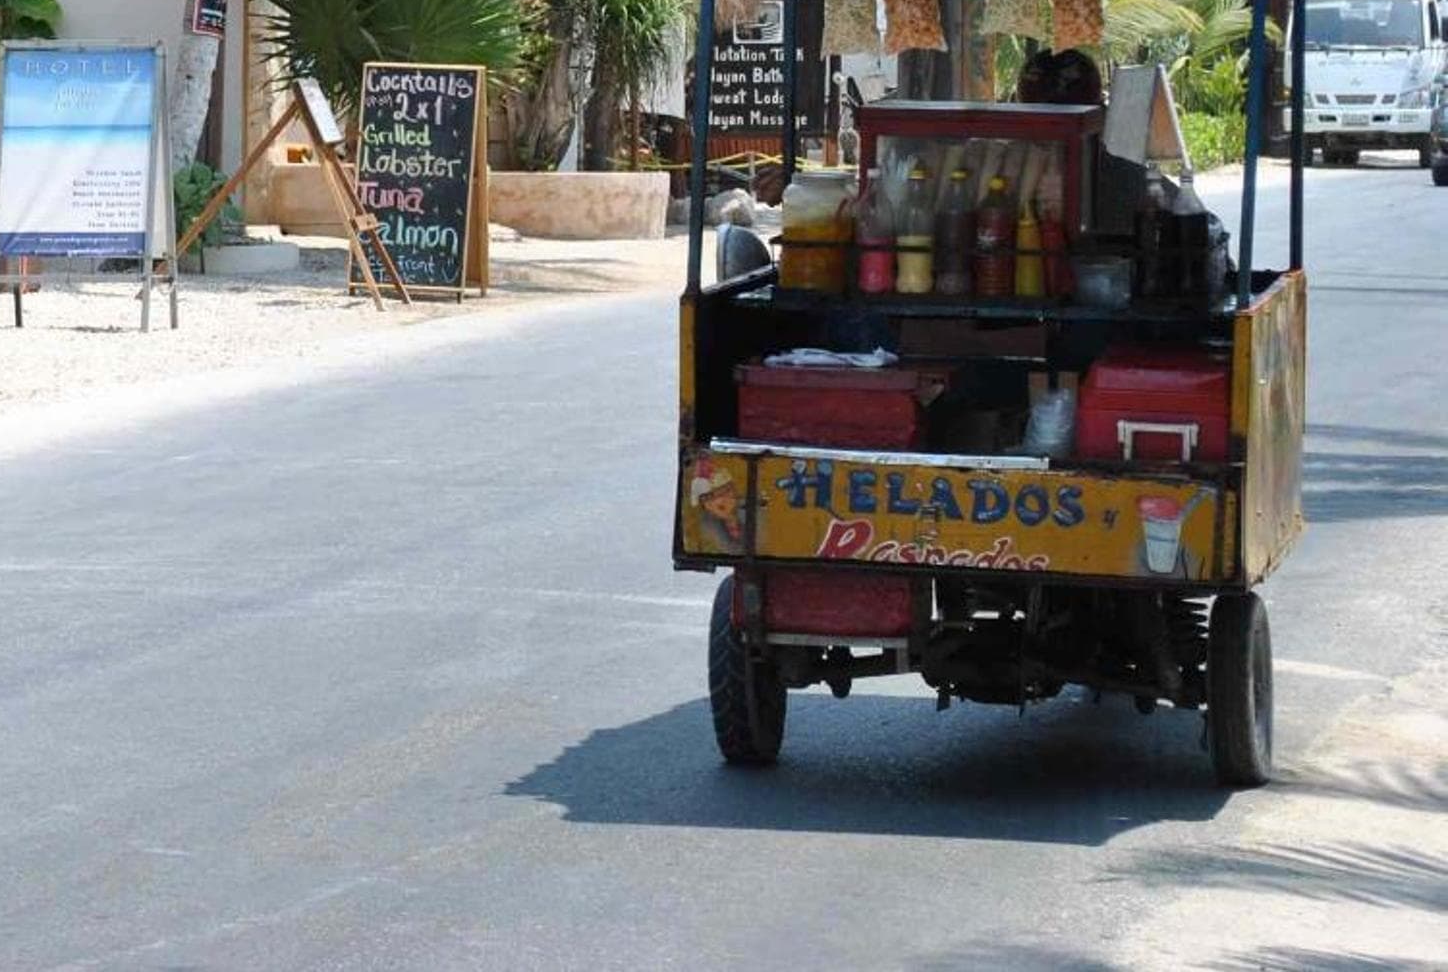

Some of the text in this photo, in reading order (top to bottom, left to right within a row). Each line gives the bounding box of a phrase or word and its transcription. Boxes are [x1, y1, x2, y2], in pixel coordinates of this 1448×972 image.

[714, 46, 767, 62] lotation
[711, 68, 746, 87] ayan
[712, 89, 747, 105] weat
[708, 110, 744, 131] ayan
[364, 123, 432, 146] Grilled
[358, 181, 425, 215] Tuna
[776, 457, 1087, 527] HELADOS
